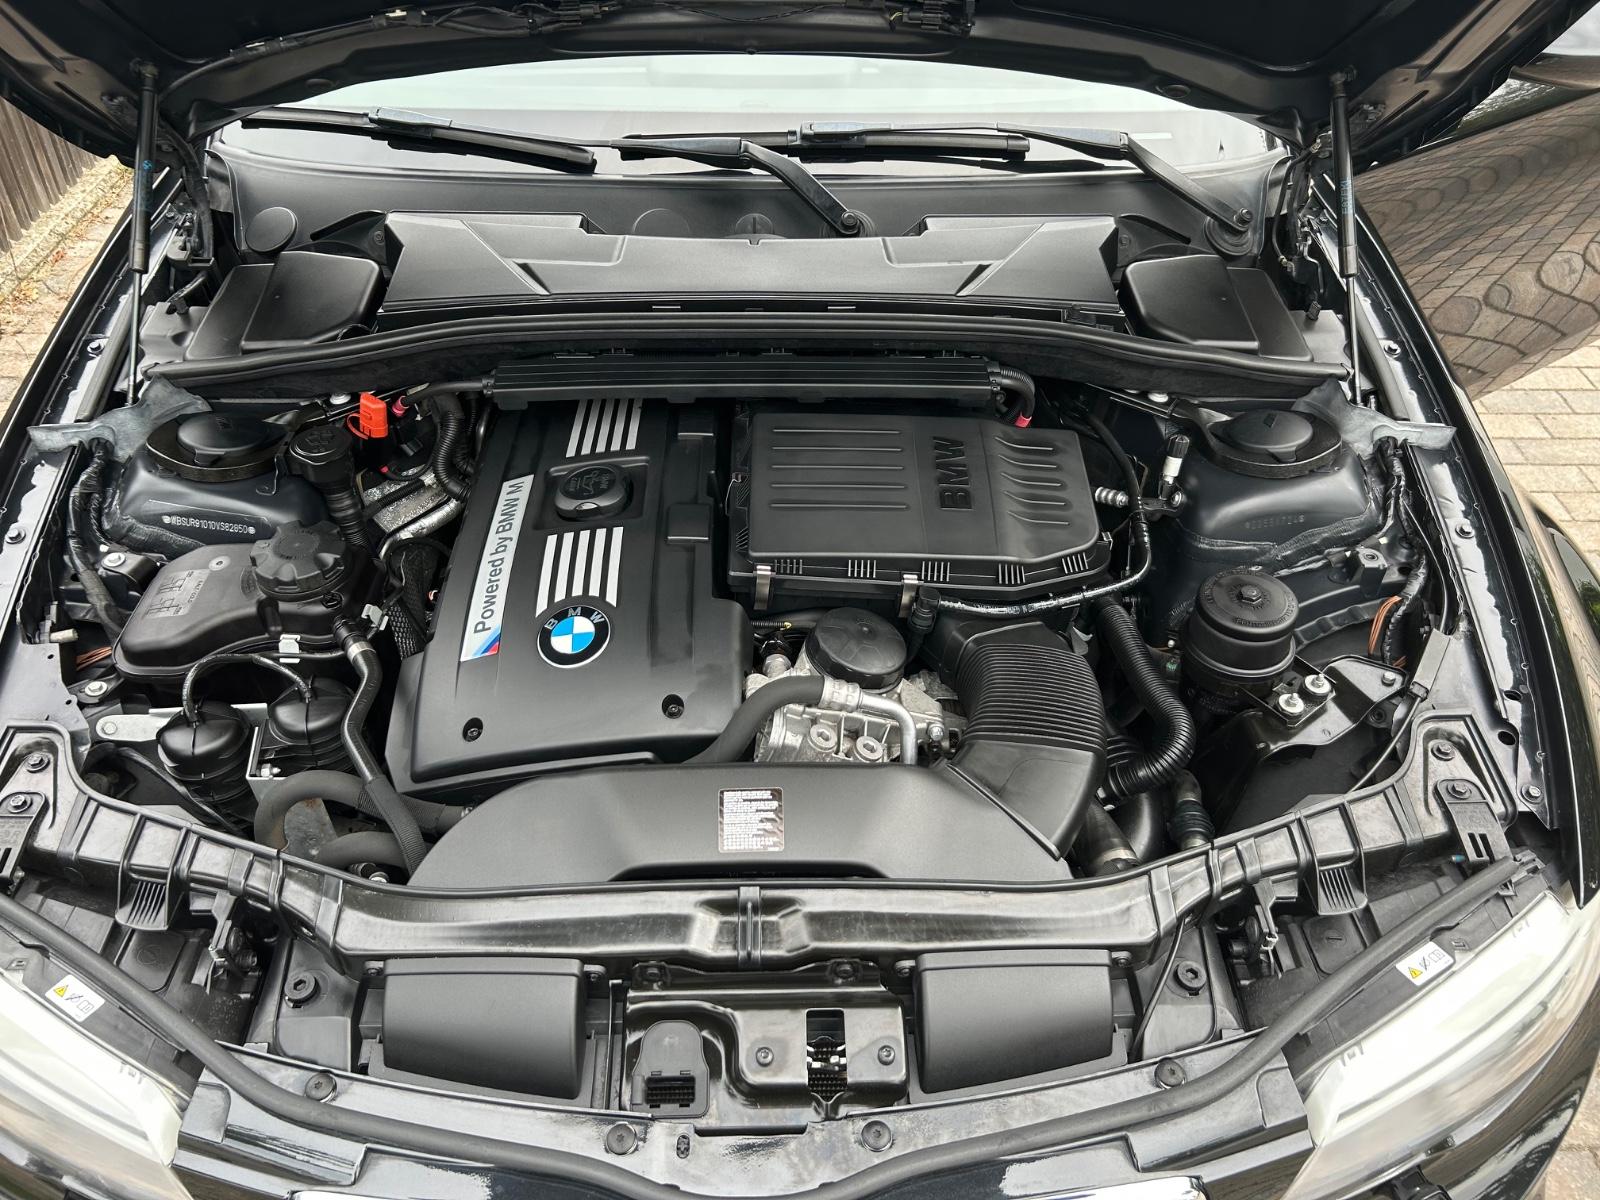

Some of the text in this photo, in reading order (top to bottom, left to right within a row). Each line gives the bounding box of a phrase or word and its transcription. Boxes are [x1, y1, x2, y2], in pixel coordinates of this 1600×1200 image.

[932, 436, 973, 510] BMW
[474, 481, 525, 634] Powered by BMW M
[544, 606, 605, 630] BMW
